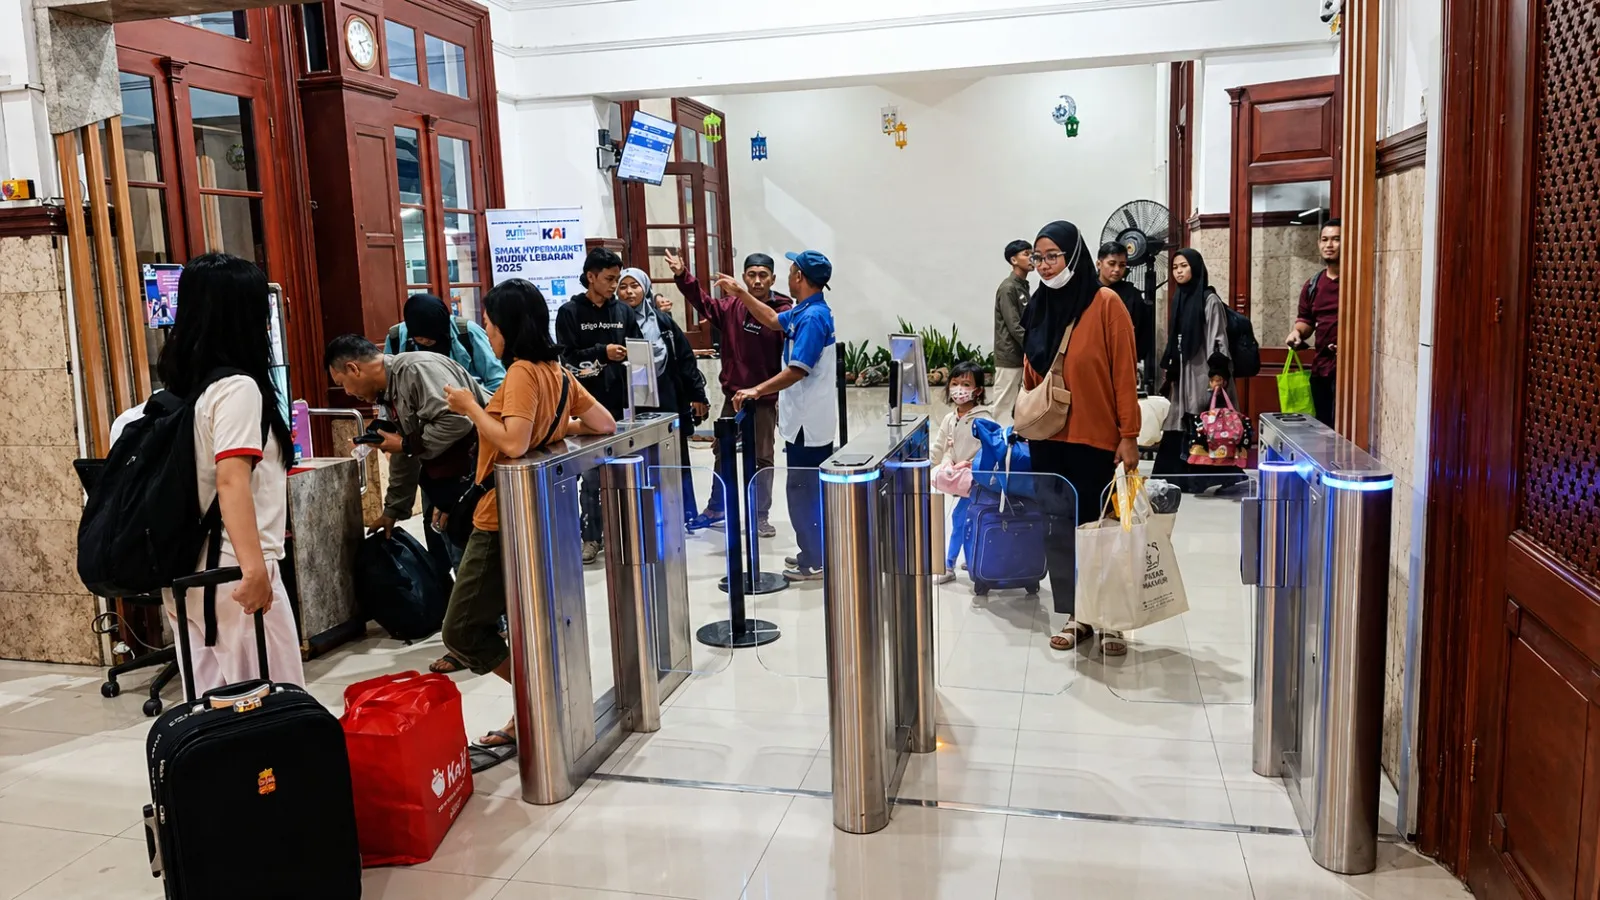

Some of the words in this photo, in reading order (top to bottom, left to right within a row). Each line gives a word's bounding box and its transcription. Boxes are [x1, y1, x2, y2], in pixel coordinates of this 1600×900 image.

[494, 247, 521, 255] SMAK
[522, 244, 583, 254] HYPERMARKET
[495, 254, 528, 263] MUDIK
[529, 252, 574, 262] LEBARAN
[496, 263, 522, 273] 2025
